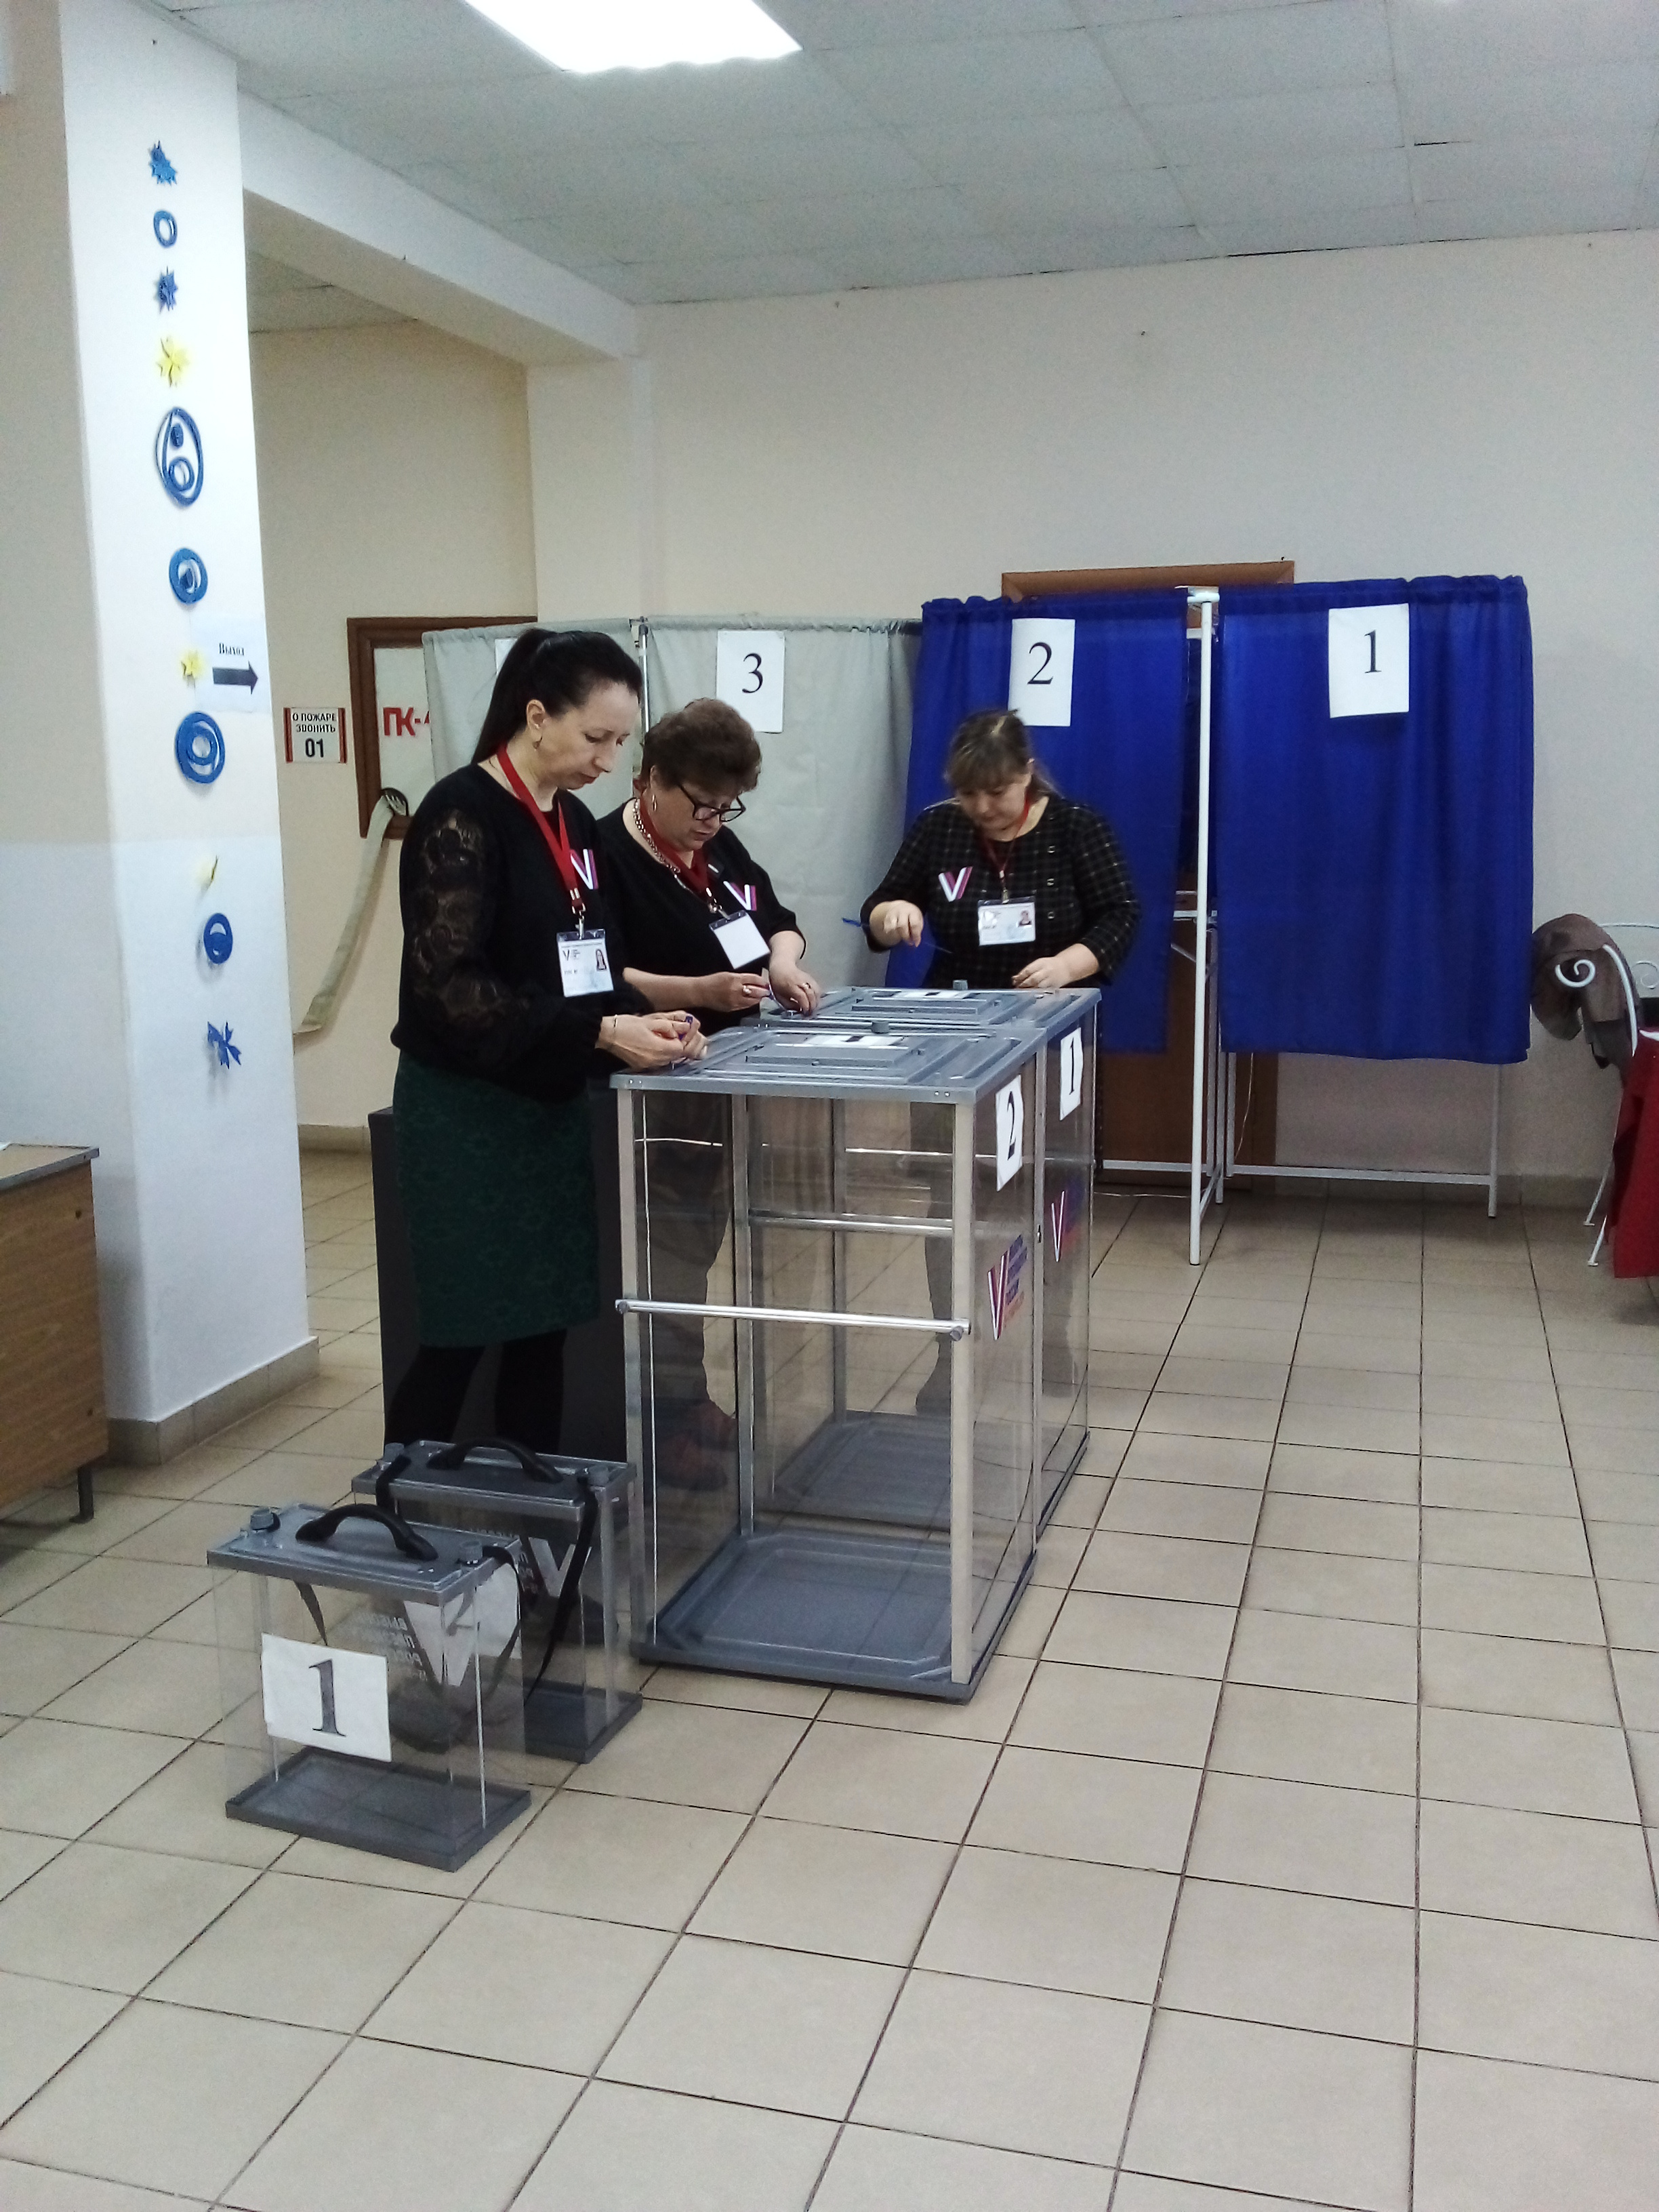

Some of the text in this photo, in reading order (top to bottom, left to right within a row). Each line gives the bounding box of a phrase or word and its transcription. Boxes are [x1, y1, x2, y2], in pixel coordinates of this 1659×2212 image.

[219, 642, 245, 656] Выход
[1027, 642, 1054, 684] 2
[1364, 630, 1382, 674] 1
[742, 653, 764, 693] 3
[292, 713, 337, 722] О ПОЖАРЕ
[295, 724, 336, 733] ЗВОНИТЬ
[305, 738, 324, 758] 01
[1069, 1036, 1075, 1095] 1
[1006, 1090, 1017, 1161] 2
[308, 1659, 347, 1737] 1
